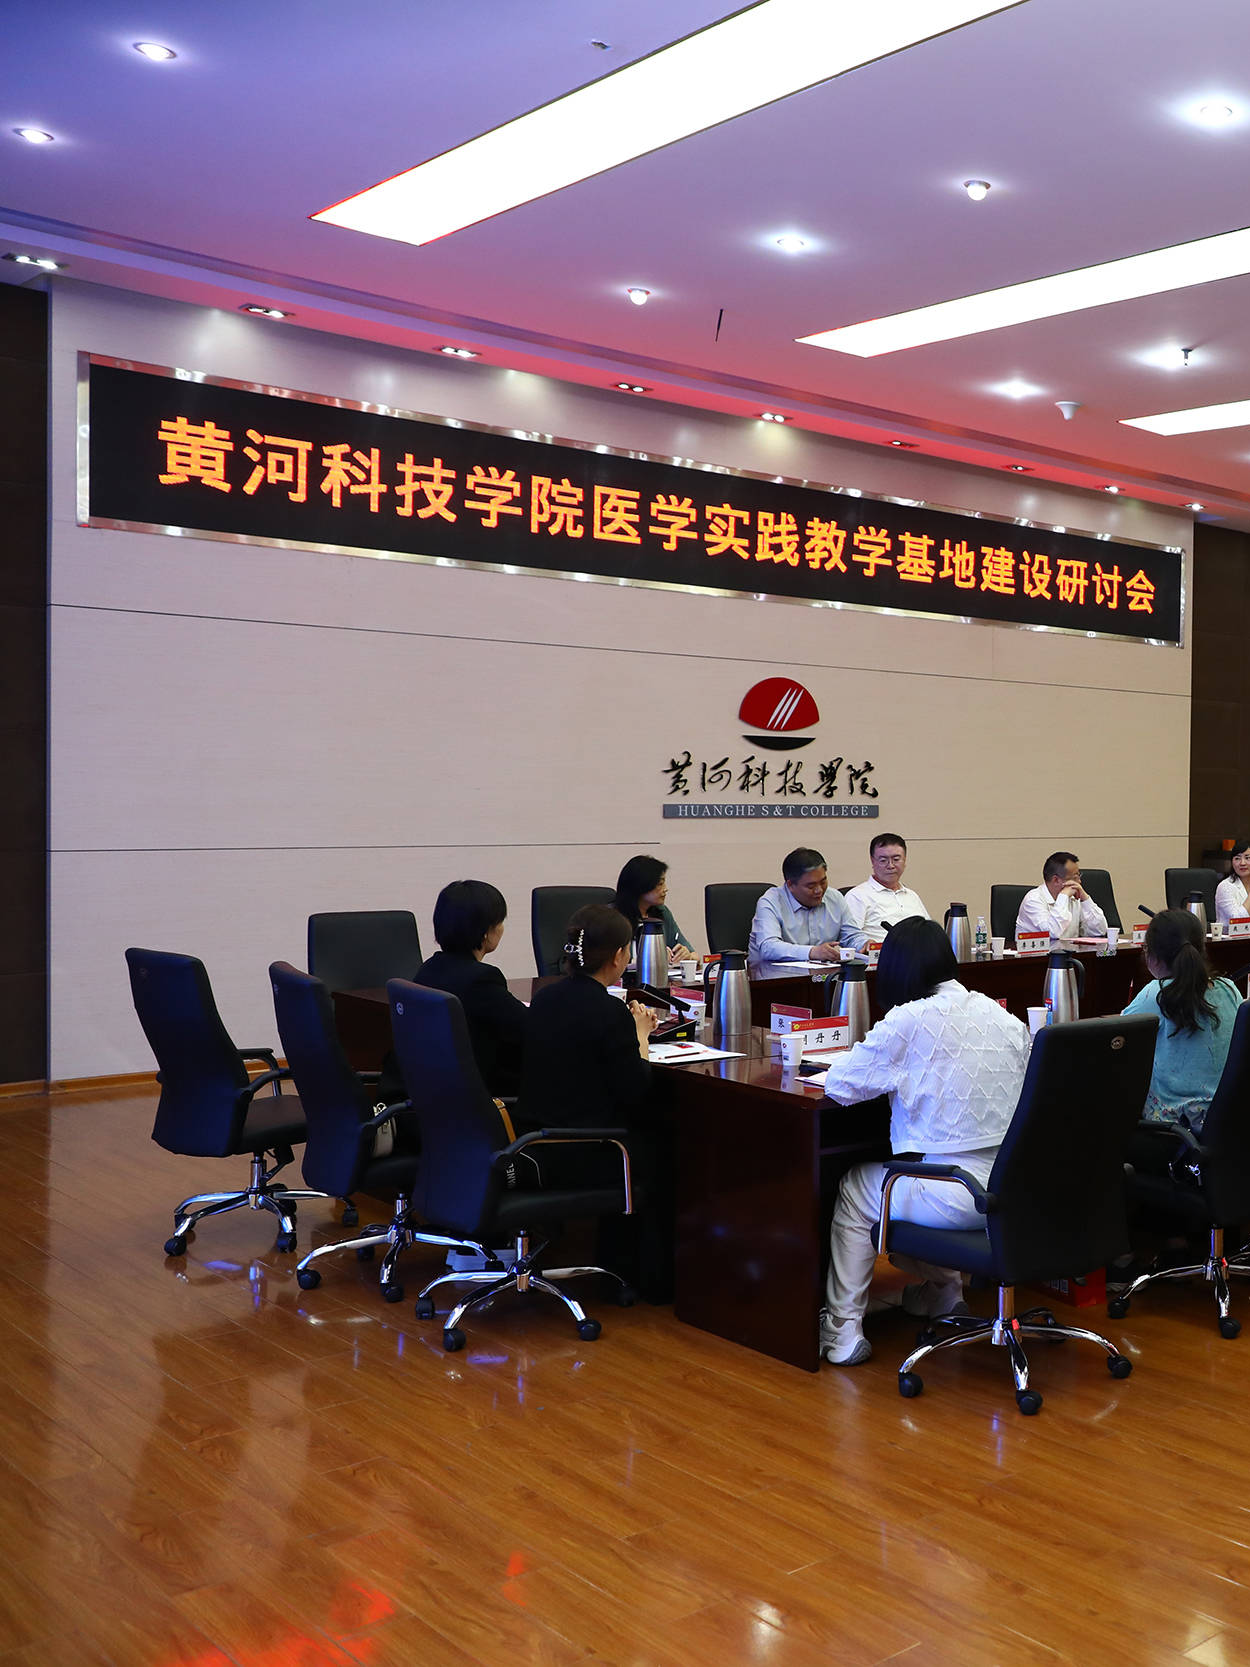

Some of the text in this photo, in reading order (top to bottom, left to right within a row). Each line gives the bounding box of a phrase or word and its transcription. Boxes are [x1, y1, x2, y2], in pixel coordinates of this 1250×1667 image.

[157, 416, 1156, 614] 黄河科技学院医学实践教学基地建设研讨会
[679, 805, 756, 817] HUANGHE
[800, 805, 869, 817] COLLEGE
